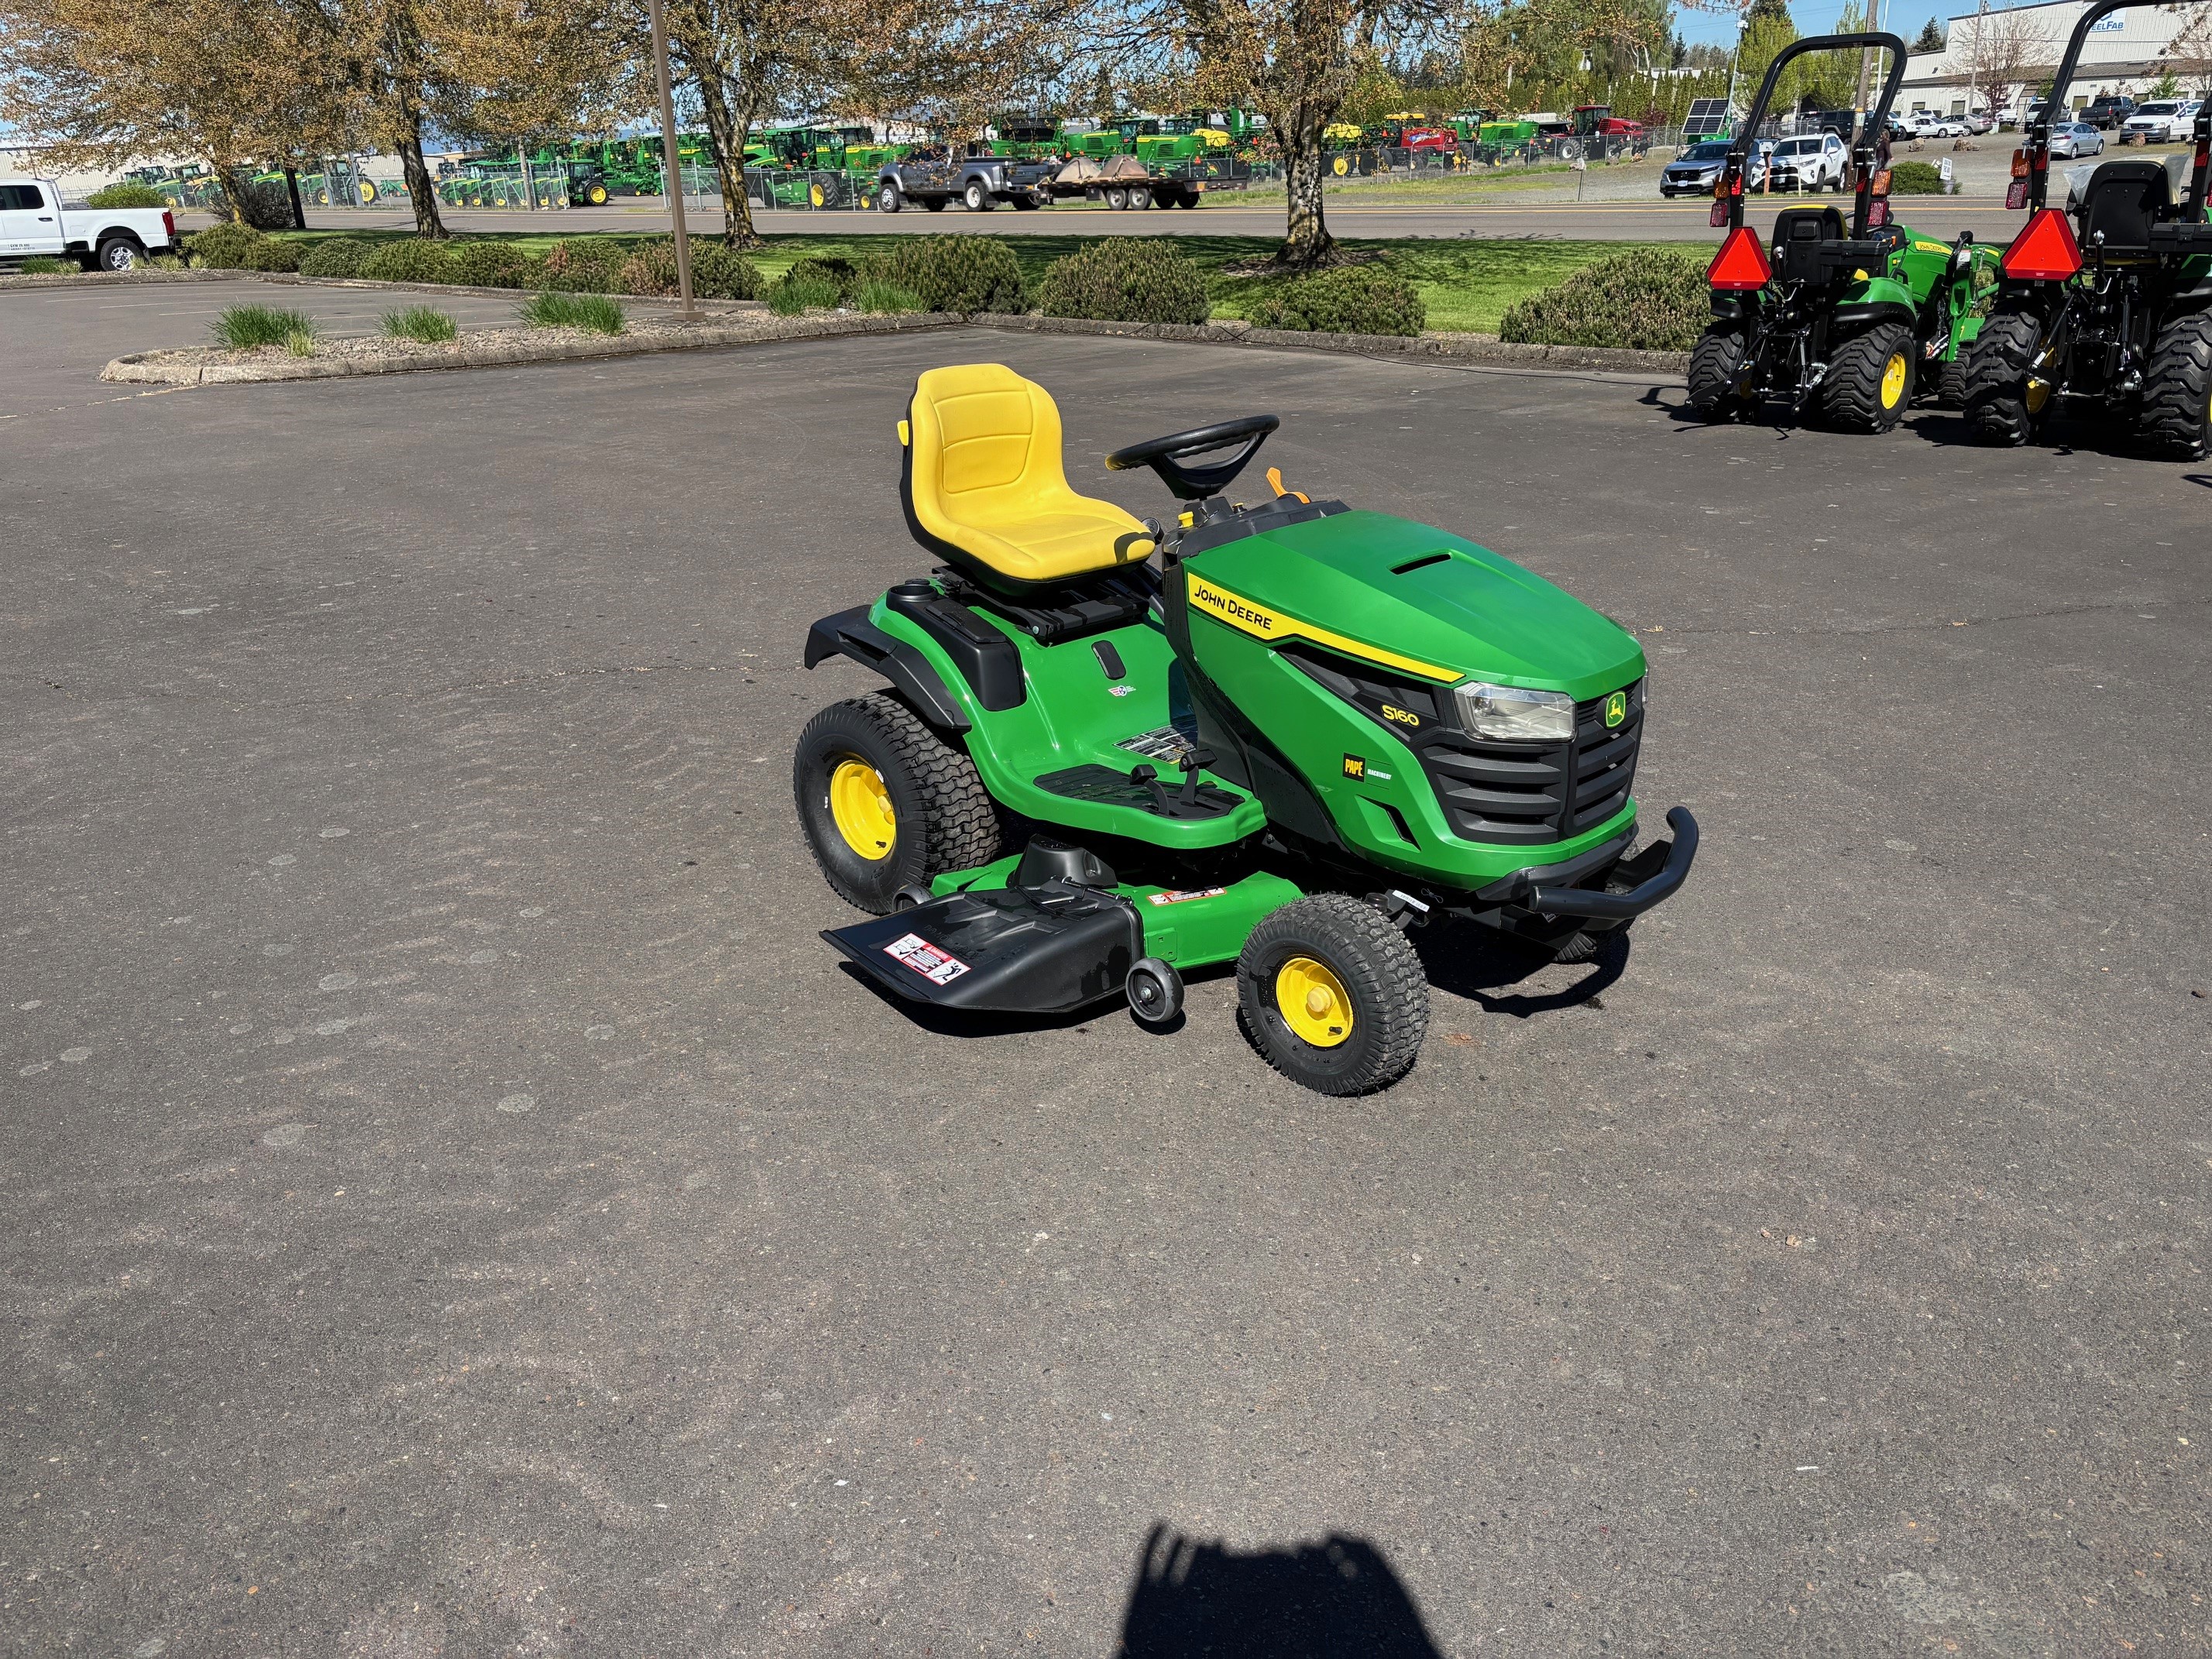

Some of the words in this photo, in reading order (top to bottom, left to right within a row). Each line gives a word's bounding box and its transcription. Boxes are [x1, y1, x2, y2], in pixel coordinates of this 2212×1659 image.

[2092, 21, 2124, 30] EELFAB
[1194, 584, 1226, 610] JOHN
[1228, 599, 1273, 630] DEERE
[1381, 704, 1420, 727] S160
